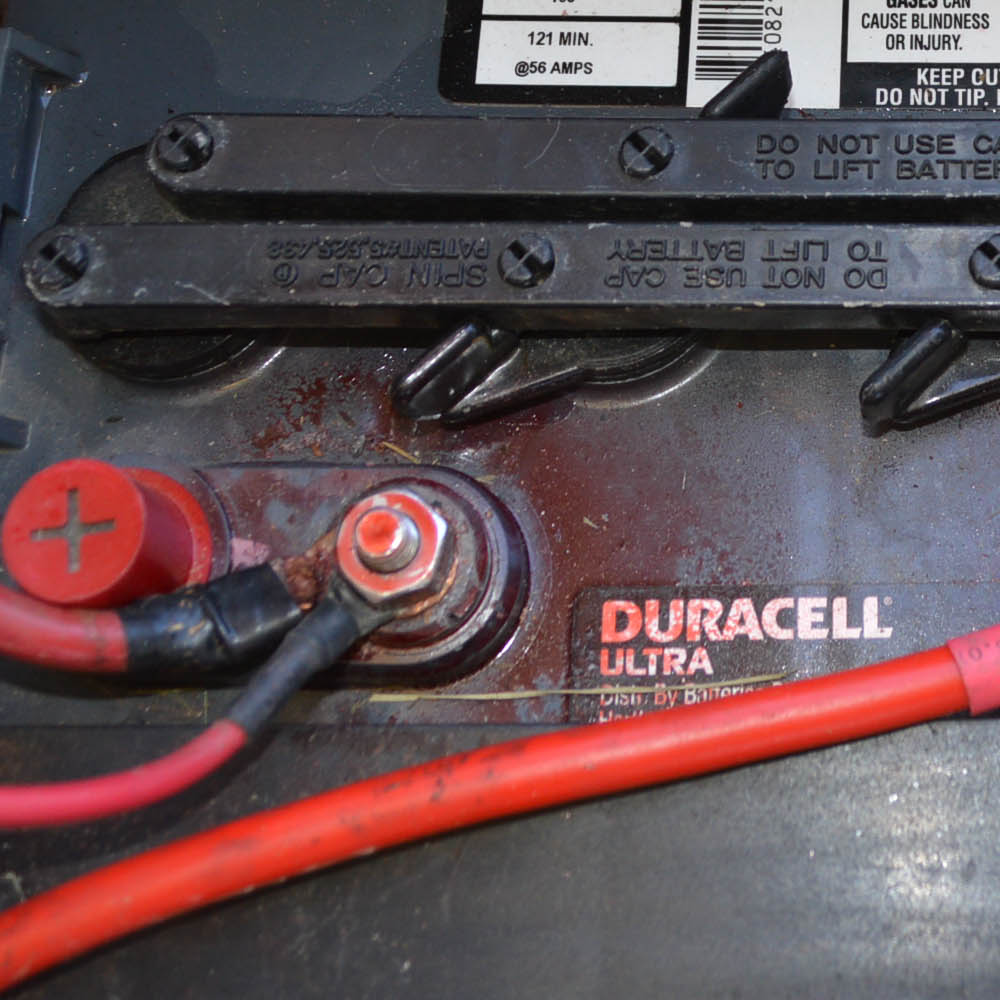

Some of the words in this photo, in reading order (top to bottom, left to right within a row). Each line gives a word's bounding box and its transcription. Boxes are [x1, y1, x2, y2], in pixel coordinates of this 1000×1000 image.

[861, 13, 907, 29] CAUSE
[911, 13, 990, 29] BLINDNESS
[527, 30, 554, 46] 121
[559, 31, 594, 47] MIN.
[885, 34, 906, 51] OR
[910, 34, 963, 51] INJURY.
[514, 61, 547, 77] @56
[550, 61, 594, 75] AMPS
[917, 68, 965, 87] KEEP
[876, 88, 903, 106] DO
[909, 88, 950, 106] NOT
[954, 88, 989, 107] TIP.
[756, 134, 800, 155] DO
[816, 134, 880, 155] NOT
[895, 134, 956, 155] USE
[754, 158, 795, 180] TO
[813, 159, 881, 180] LIFT
[607, 239, 745, 262] BATTERY
[761, 239, 829, 262] LIFT
[847, 239, 888, 262] TO
[319, 263, 388, 288] CAP
[407, 263, 488, 288] SPIN
[604, 266, 665, 289] CAP
[683, 266, 746, 289] USE
[762, 266, 825, 289] NOT
[844, 266, 888, 289] DO
[600, 647, 714, 676] ULTRA
